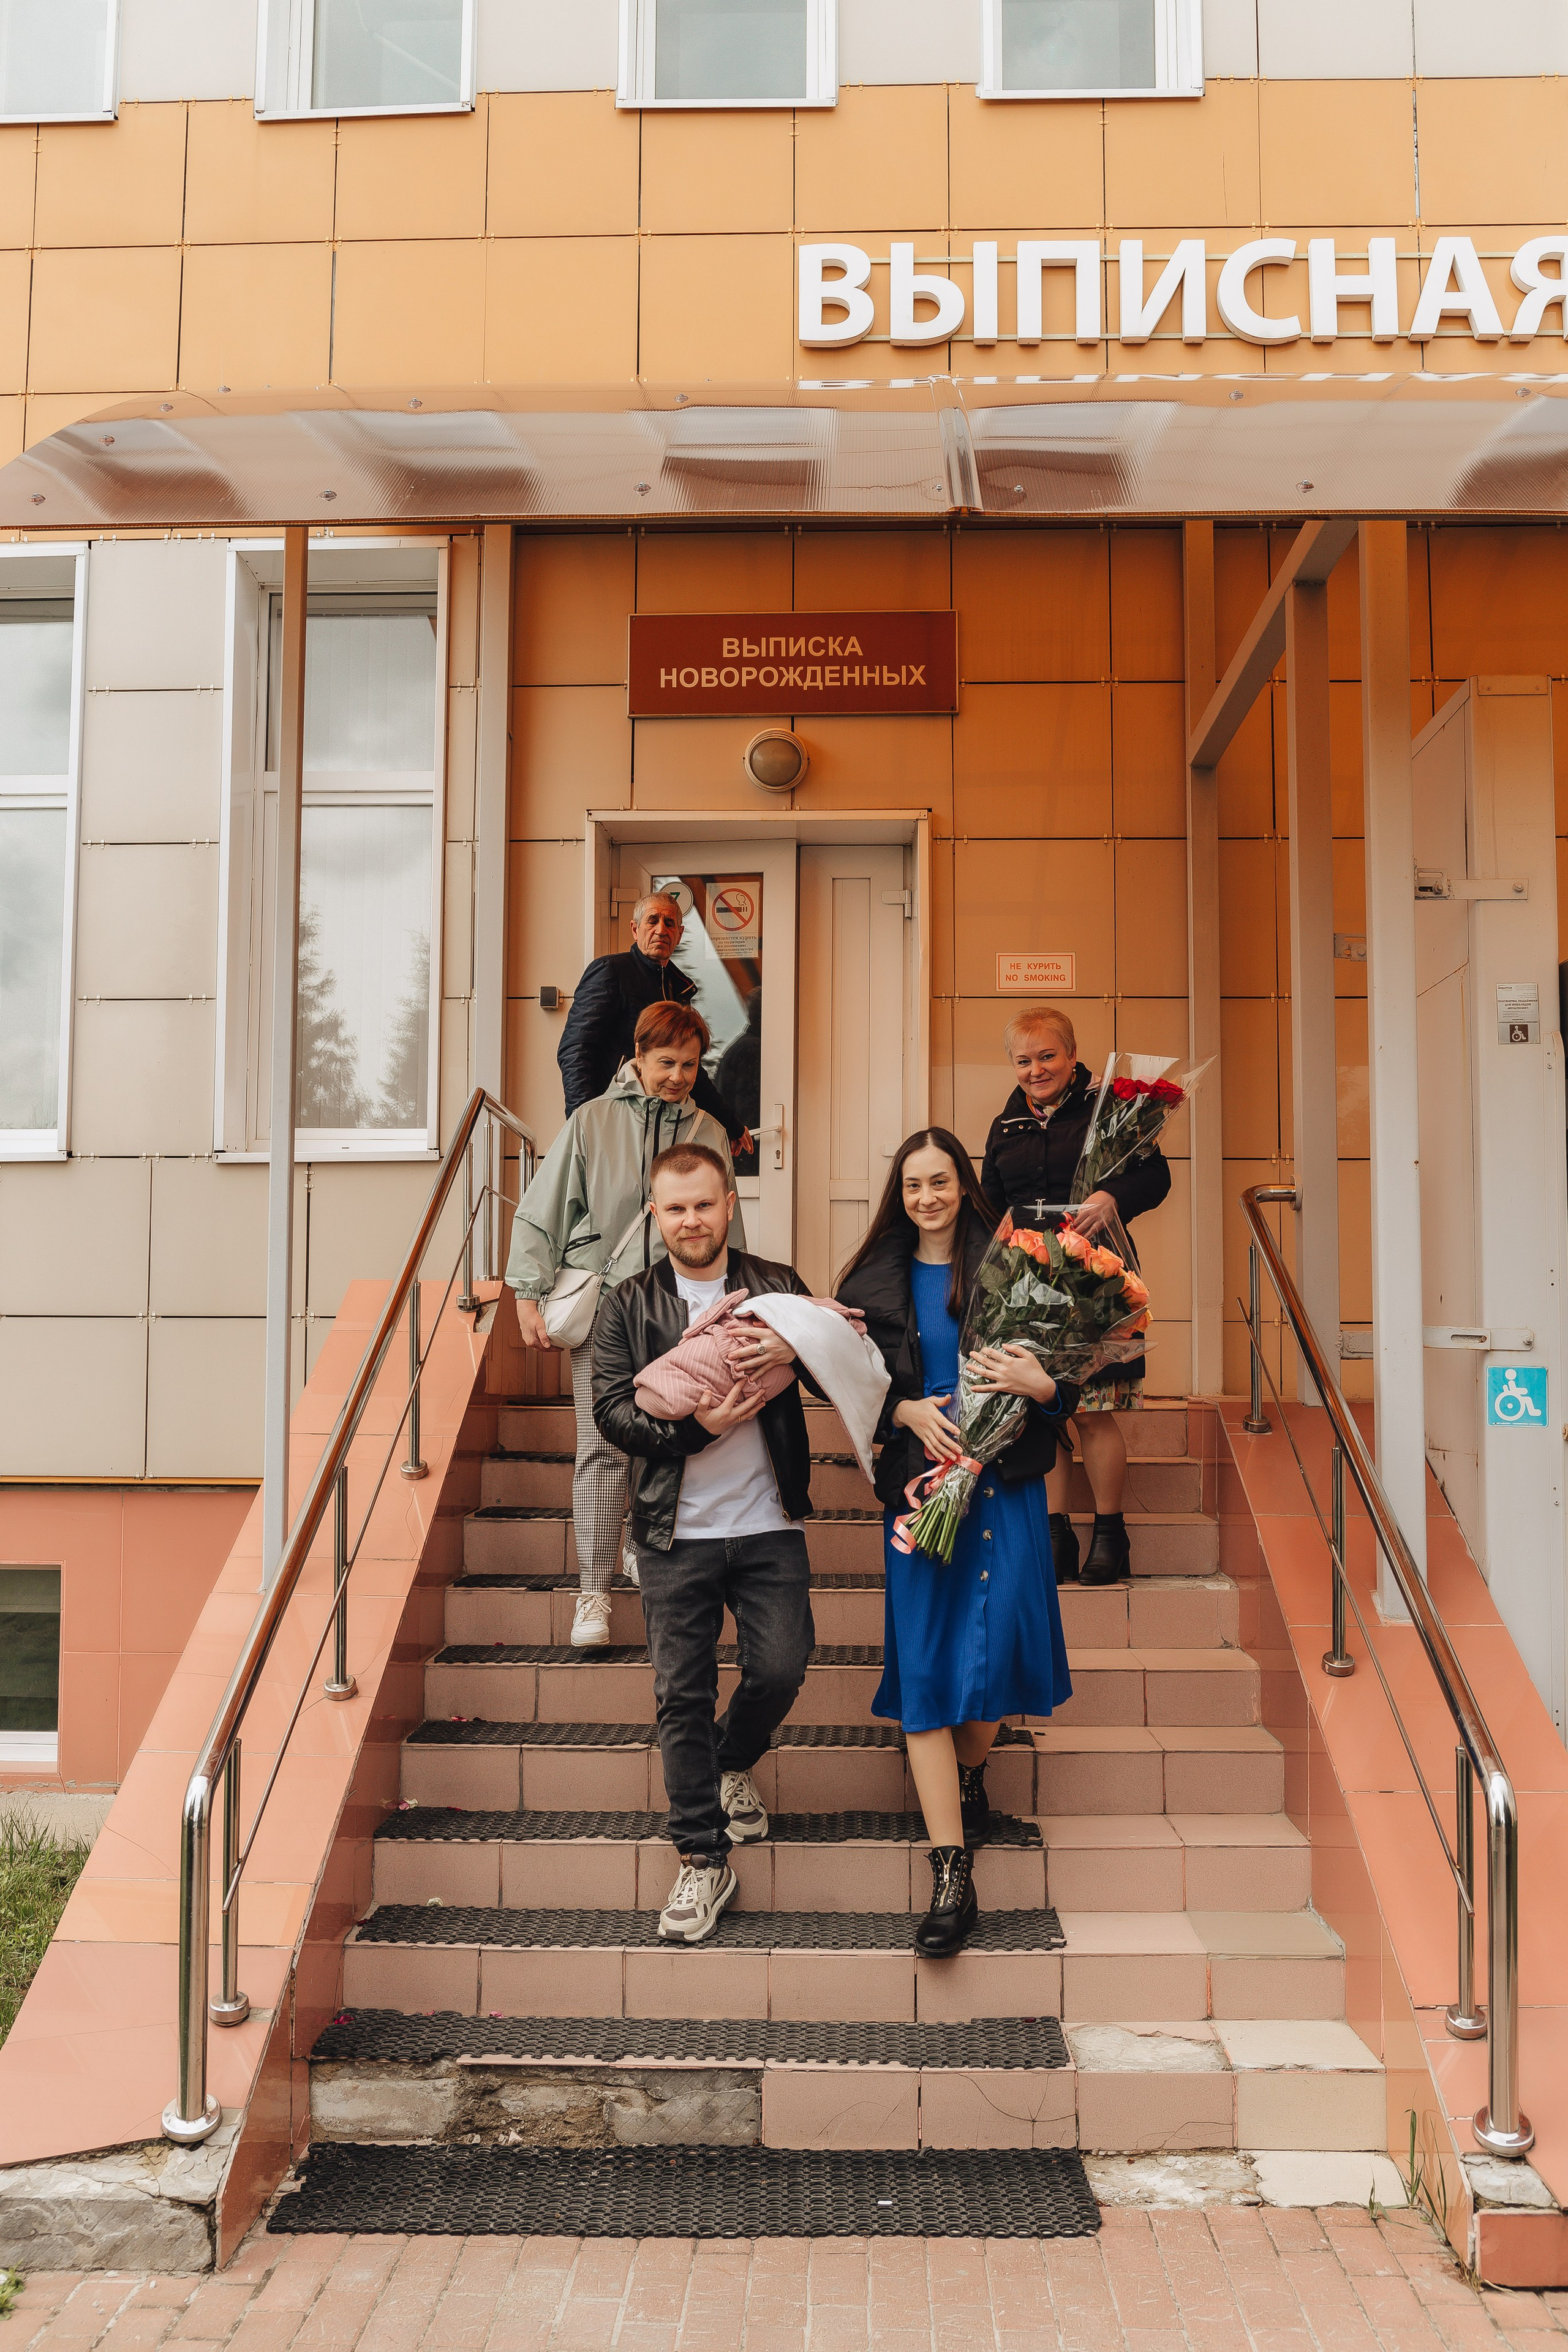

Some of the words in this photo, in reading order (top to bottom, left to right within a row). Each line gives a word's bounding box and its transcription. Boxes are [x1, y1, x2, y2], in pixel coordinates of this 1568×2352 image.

[798, 235, 1568, 347] ВЫПИСНАЯ
[723, 636, 864, 658] ВЫПИСКА
[660, 665, 926, 690] НОВОРОЖДЕННЫХ
